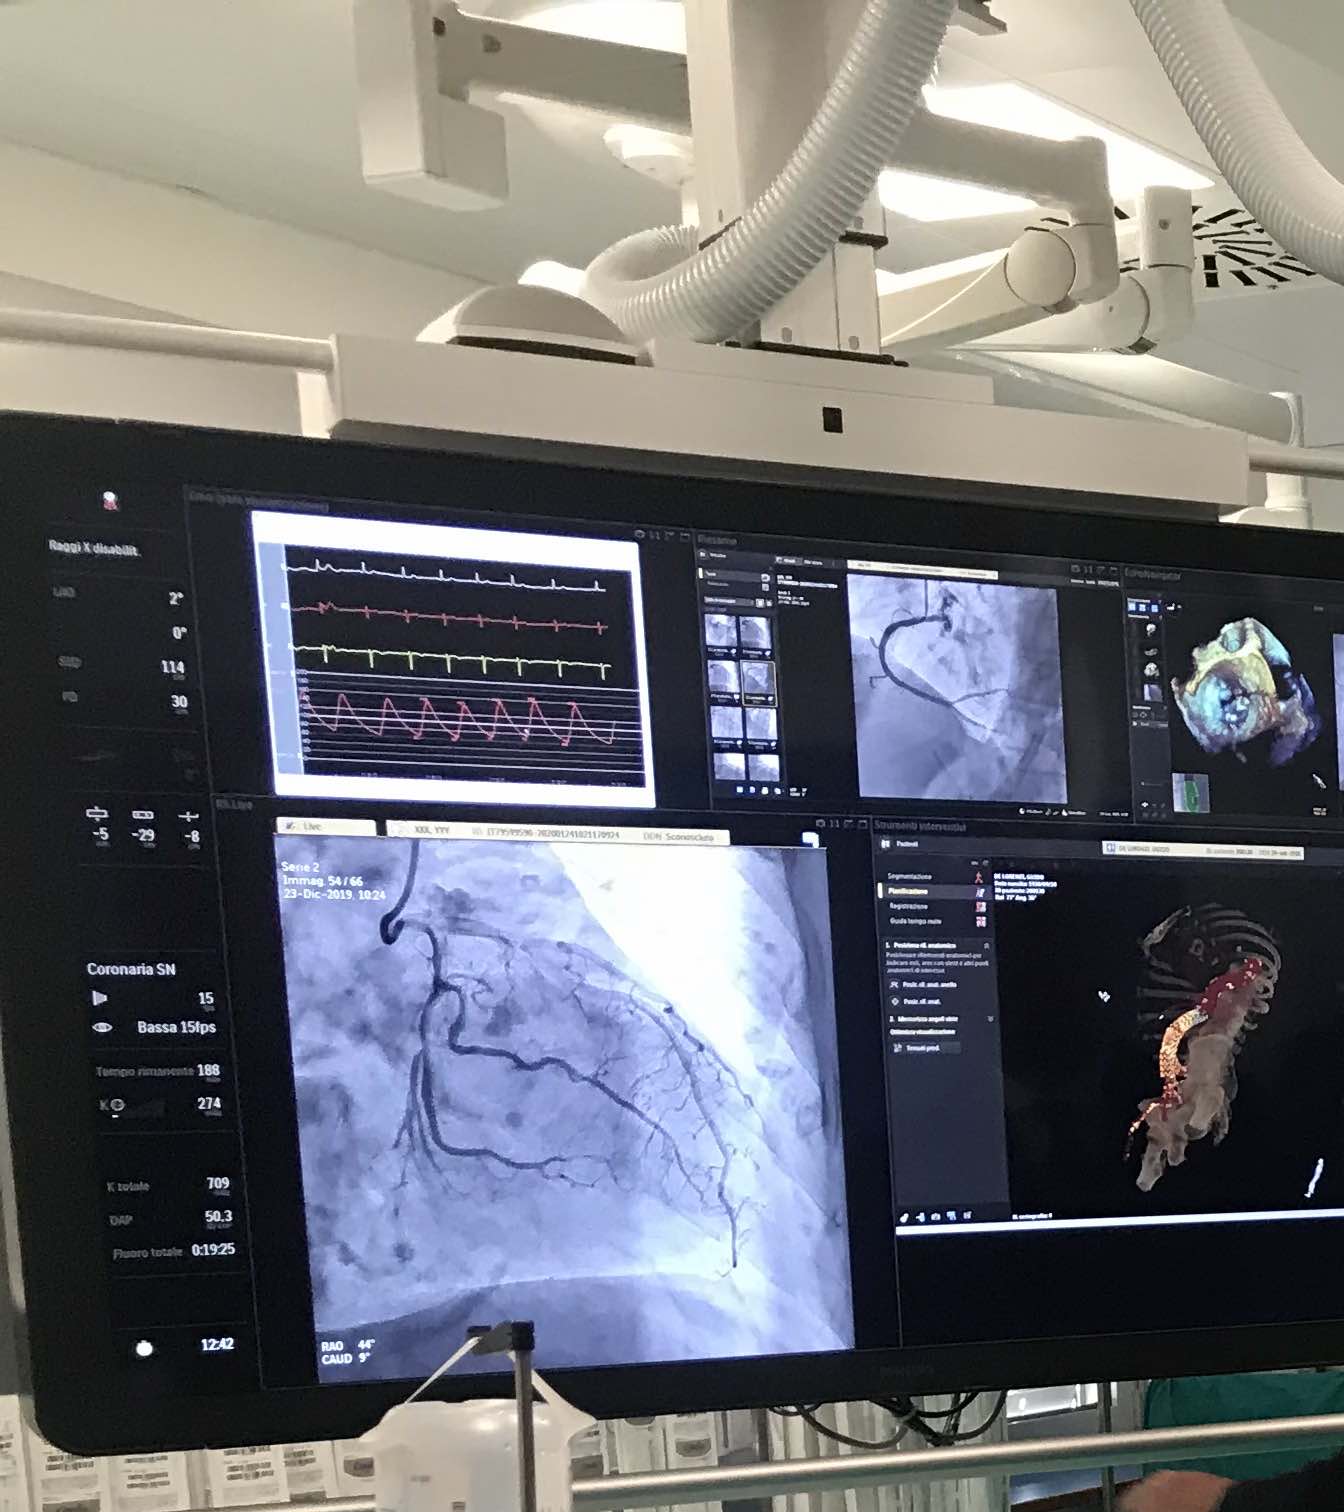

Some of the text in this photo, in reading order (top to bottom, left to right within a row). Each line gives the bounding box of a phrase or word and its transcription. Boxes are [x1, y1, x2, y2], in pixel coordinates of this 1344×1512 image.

[48, 539, 81, 554] Raggi
[83, 541, 92, 553] X
[162, 660, 185, 674] 114
[172, 695, 188, 708] 30
[93, 828, 201, 843] -5 -29 -8
[282, 862, 320, 873] Serie 2
[328, 876, 342, 886] 54
[349, 876, 363, 886] 66
[87, 962, 176, 976] Coronaria SN
[198, 991, 215, 1005] 15
[137, 1020, 217, 1035] Bassa 15fps
[197, 1063, 220, 1077] 188
[197, 1096, 222, 1110] 274
[207, 1177, 230, 1190] 709
[205, 1210, 233, 1223] 50.3
[191, 1242, 236, 1256] 0:19:25
[201, 1337, 235, 1351] 12:42
[321, 1341, 344, 1352] RAO
[321, 1353, 353, 1365] CAUD
